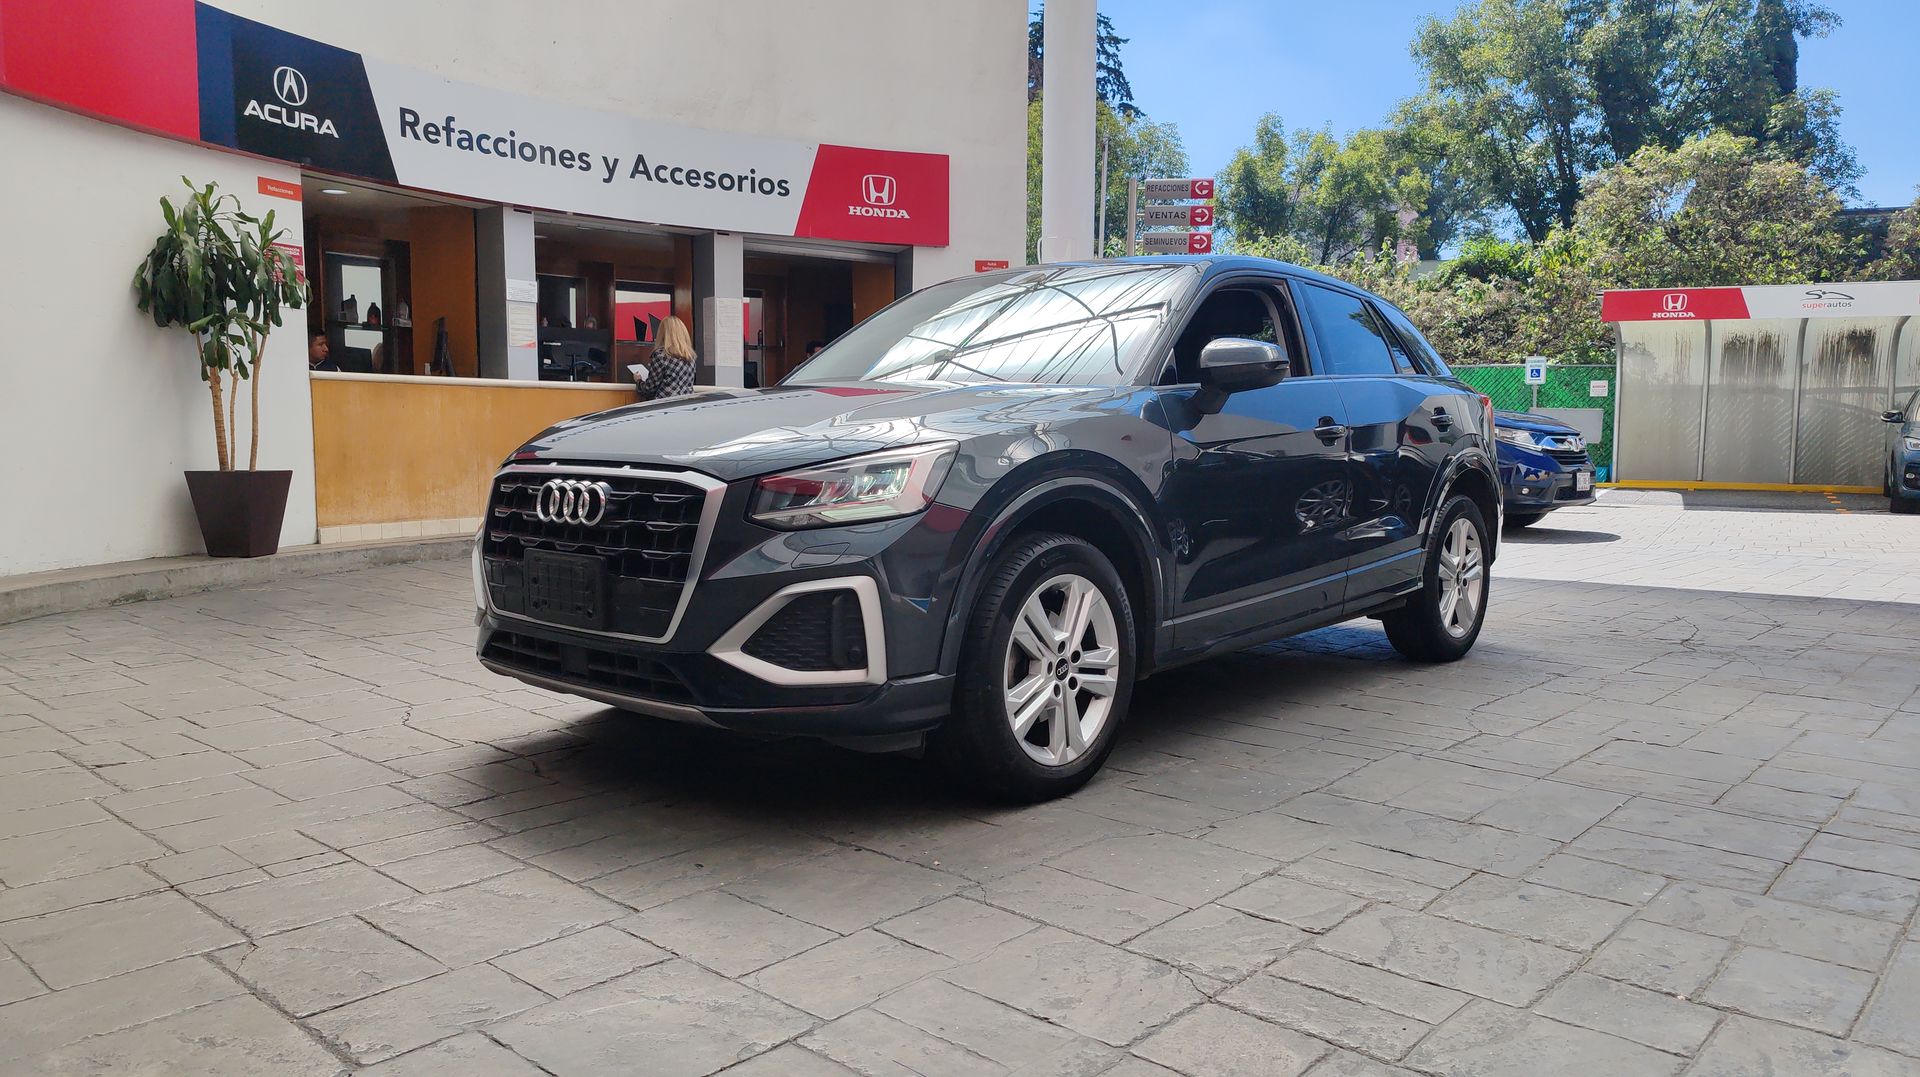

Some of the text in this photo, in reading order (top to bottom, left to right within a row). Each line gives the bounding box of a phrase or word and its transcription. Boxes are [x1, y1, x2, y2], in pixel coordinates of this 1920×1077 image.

[243, 99, 340, 139] ACURA
[399, 106, 791, 198] Refacciones y Accesorios
[267, 184, 294, 196] Refacciones
[1146, 184, 1189, 192] REFACCIONES
[848, 205, 911, 219] HONDA
[1149, 211, 1187, 219] VENTAS
[1145, 237, 1188, 246] SEMINUEVOS
[1802, 301, 1852, 310] superautos
[1651, 311, 1696, 319] HONDA
